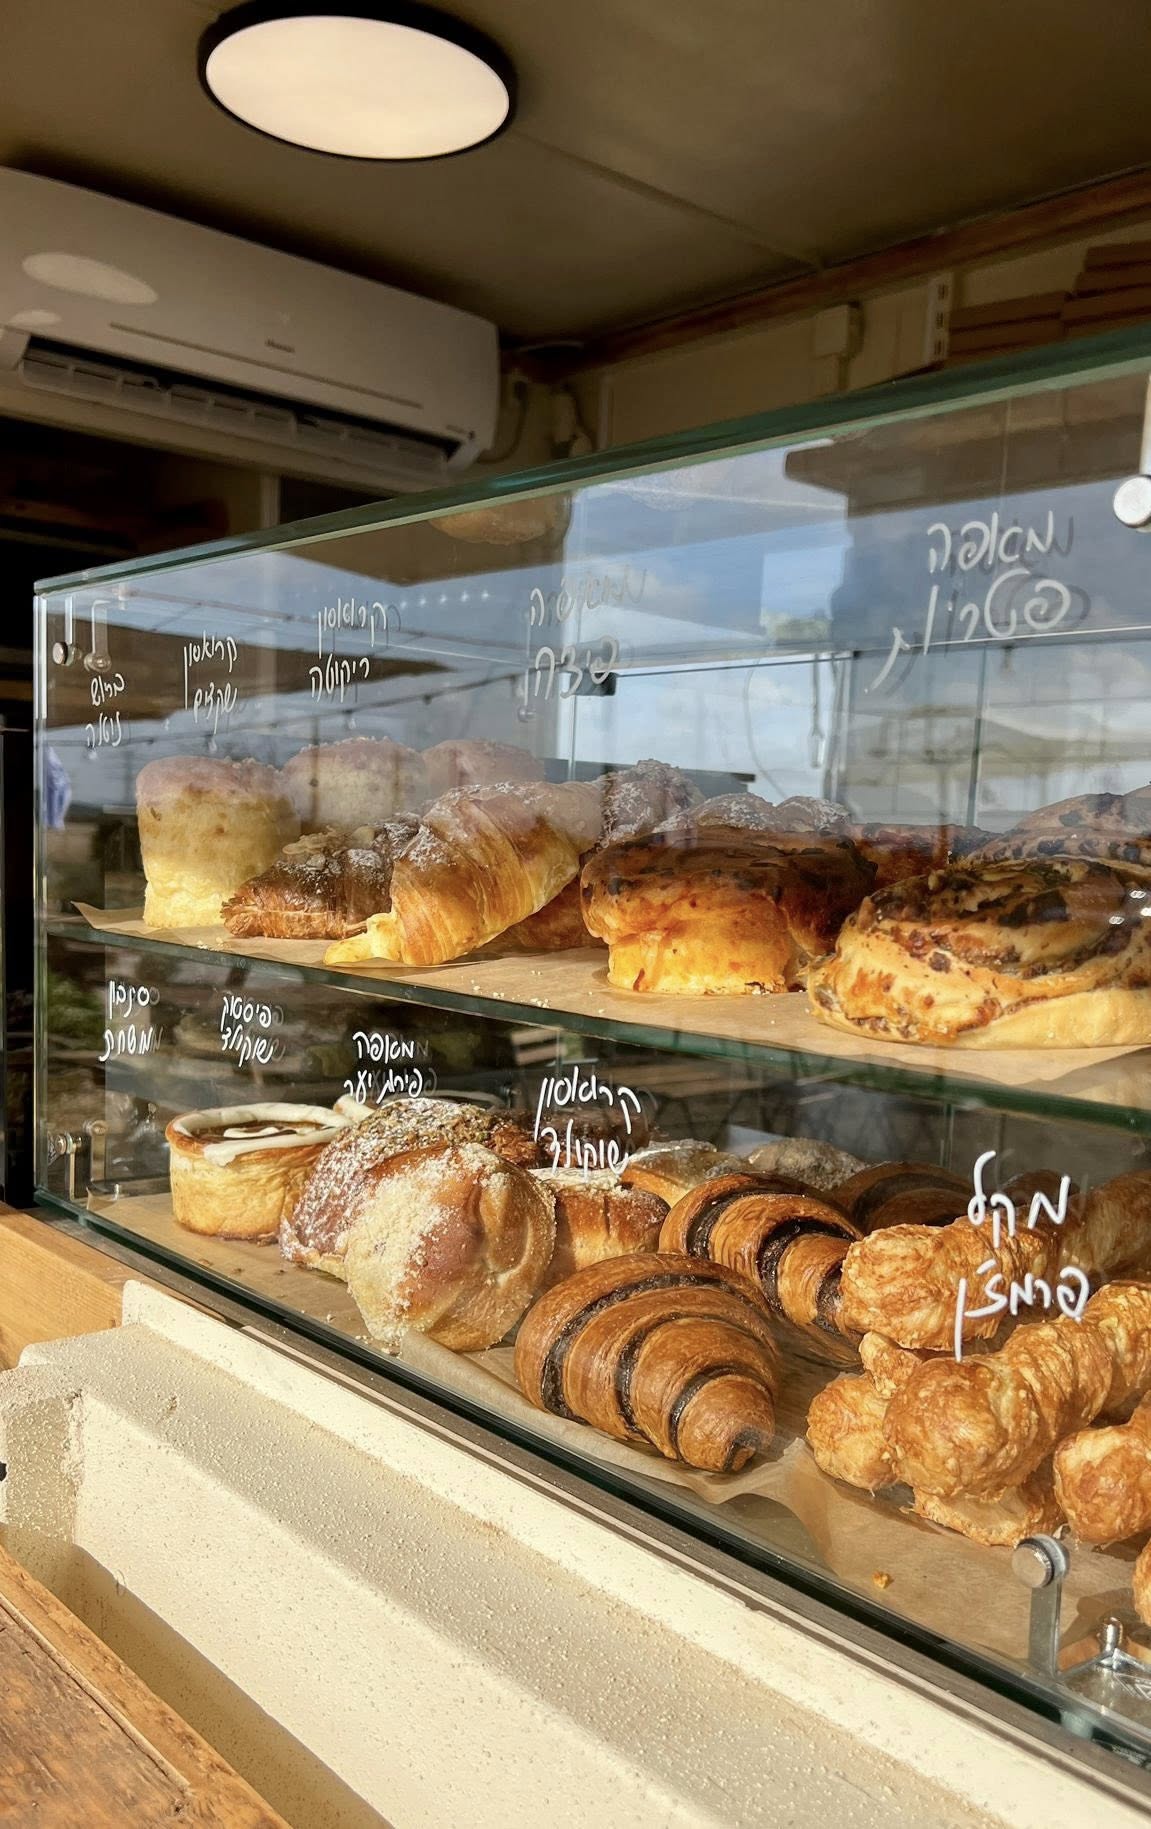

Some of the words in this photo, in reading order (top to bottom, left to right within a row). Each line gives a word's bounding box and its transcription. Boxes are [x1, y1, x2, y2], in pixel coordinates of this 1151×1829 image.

[927, 510, 1054, 573] מאפה
[318, 597, 387, 660] קרואסון
[863, 567, 1072, 693] פטריות
[183, 629, 238, 711] קרואסון
[308, 653, 370, 703] ריקוטה
[84, 711, 122, 748] נוטלה
[220, 995, 272, 1032] פיסטוק
[221, 1024, 274, 1067] שוקולד
[352, 1031, 415, 1064] מאפה
[343, 1069, 373, 1105] יער
[376, 1067, 423, 1105] פירות
[533, 1065, 642, 1142] קרואסון
[540, 1118, 629, 1183] שוקולד
[967, 1149, 1071, 1250] מקל
